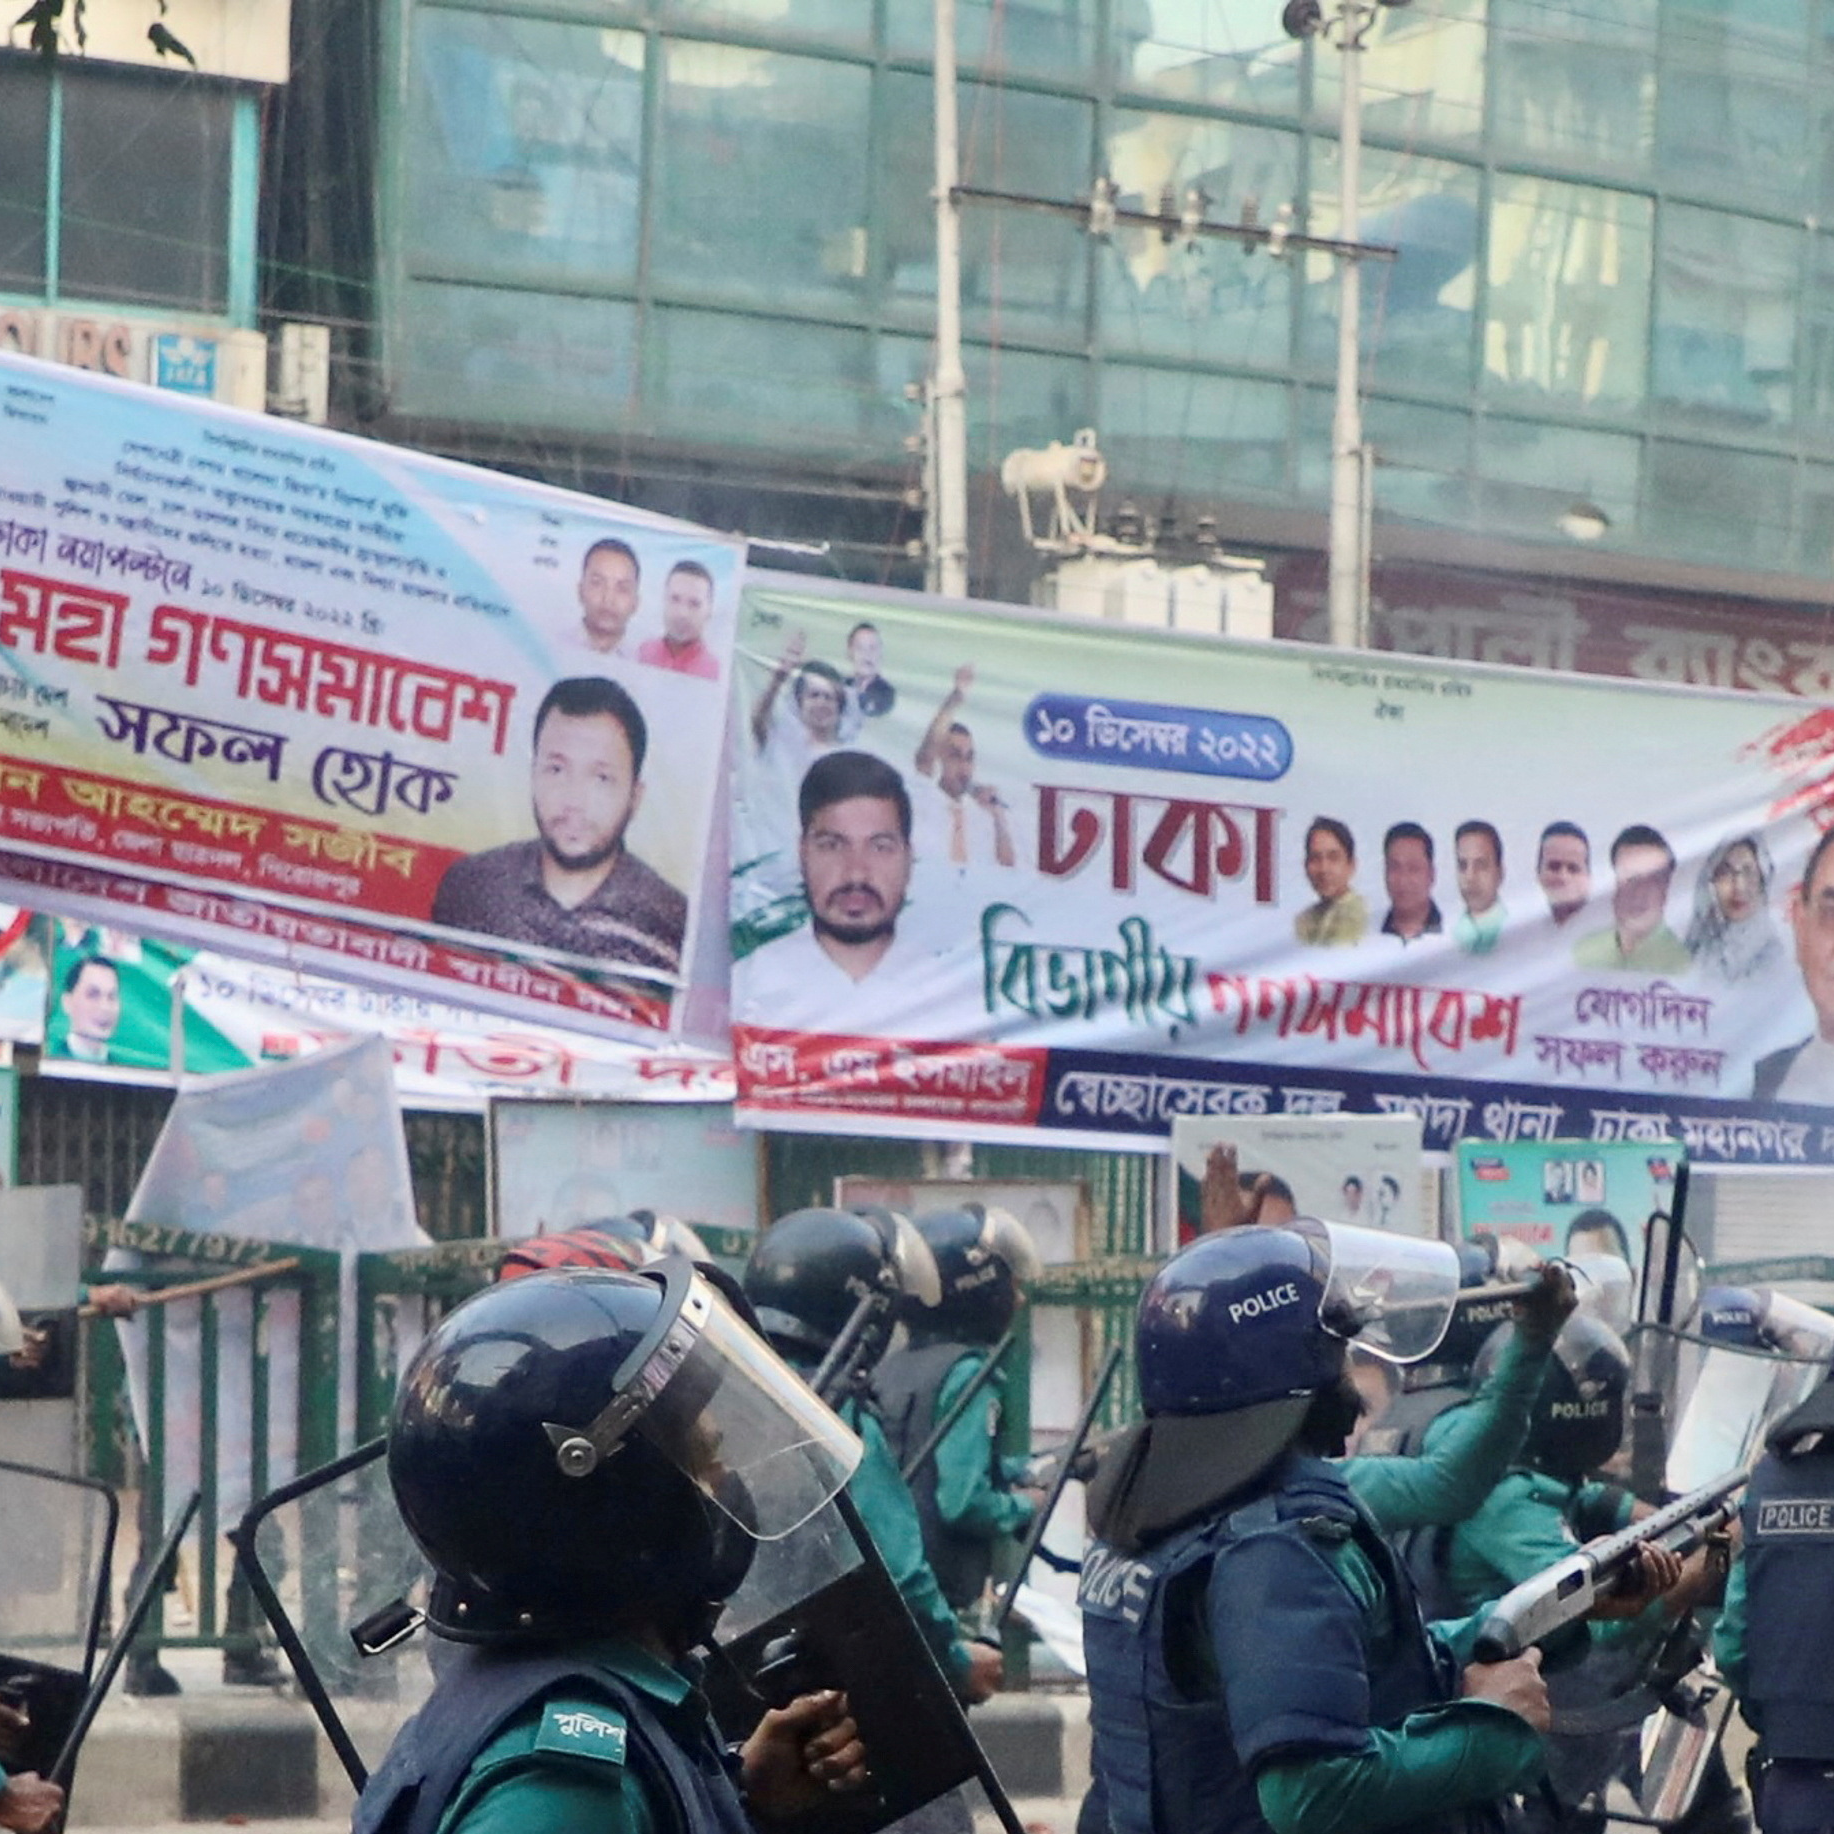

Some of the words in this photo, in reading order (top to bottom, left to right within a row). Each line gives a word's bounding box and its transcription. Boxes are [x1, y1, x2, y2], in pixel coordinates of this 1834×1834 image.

[146, 603, 520, 756] গণসমাবেশ
[96, 693, 289, 782] সফল
[312, 746, 460, 816] হোক
[1035, 708, 1076, 744] ১০
[1084, 702, 1189, 757] ডিসেম্বর
[1197, 726, 1281, 772] ২০২২
[279, 820, 420, 880] সজীব
[1031, 783, 1285, 904] ঢাকা
[979, 901, 1199, 1042] বিভাগীয়
[1203, 971, 1523, 1070] গণসমাবেশ
[1533, 1034, 1628, 1081] সফল
[1635, 1042, 1728, 1088] করুন
[1482, 1095, 1565, 1143] থানা
[1590, 1106, 1671, 1141] ঢাকা
[1227, 1282, 1301, 1325] POLICE
[1765, 1503, 1832, 1528] POLICE
[552, 1711, 627, 1745] পুলিশ
